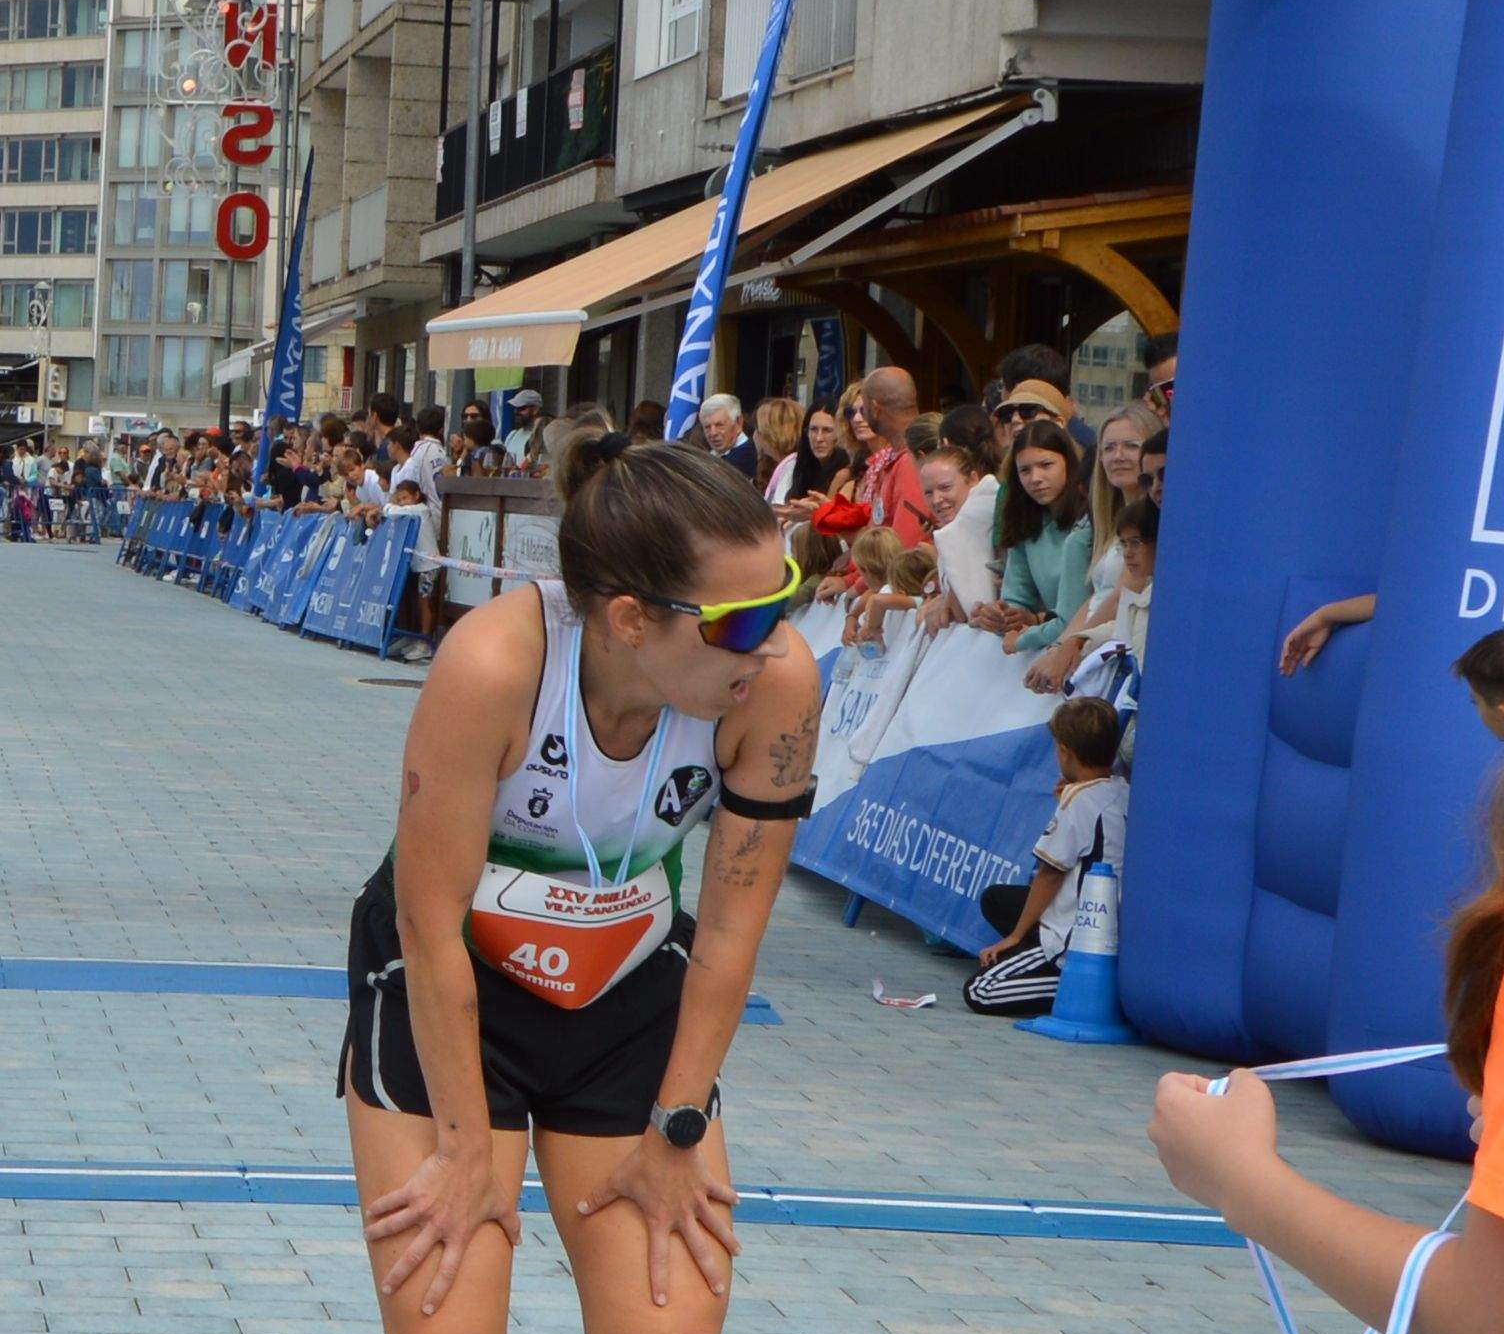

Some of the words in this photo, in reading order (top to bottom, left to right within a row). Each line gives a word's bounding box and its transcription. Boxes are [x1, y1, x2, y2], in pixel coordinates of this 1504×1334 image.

[847, 798, 885, 851] 365
[873, 801, 915, 868] DÍAS
[545, 884, 589, 904] XXV
[592, 884, 640, 904] MILLA
[583, 891, 652, 916] SANXENXO
[1077, 901, 1108, 915] LICIA
[1075, 915, 1101, 929] CAL
[508, 943, 570, 976] 40
[500, 959, 576, 993] Gemma
